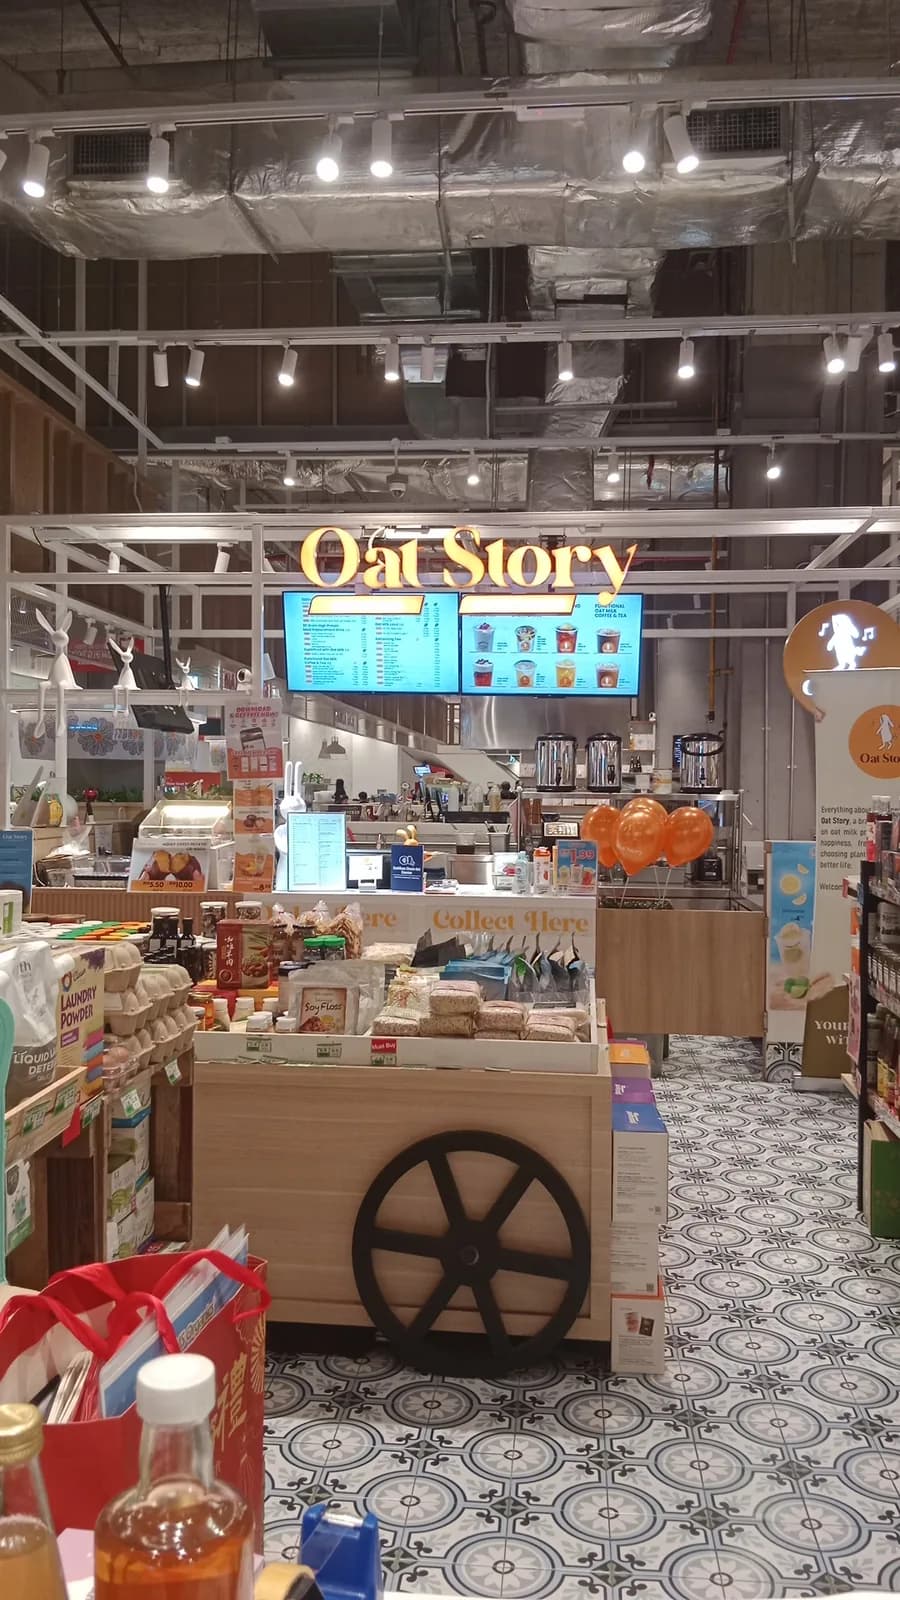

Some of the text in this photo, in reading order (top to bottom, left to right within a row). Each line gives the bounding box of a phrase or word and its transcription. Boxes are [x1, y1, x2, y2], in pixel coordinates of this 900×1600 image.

[300, 526, 637, 605] Oat Story
[860, 752, 900, 764] Oat Sto
[821, 806, 853, 815] Everything
[820, 851, 848, 859] choosing
[433, 909, 515, 930] Collect
[524, 911, 589, 932] Here
[61, 985, 97, 1012] LAUNDRY
[305, 1001, 343, 1015] Soy Floss
[60, 1004, 93, 1030] POWDER
[13, 1052, 49, 1064] LIQUID
